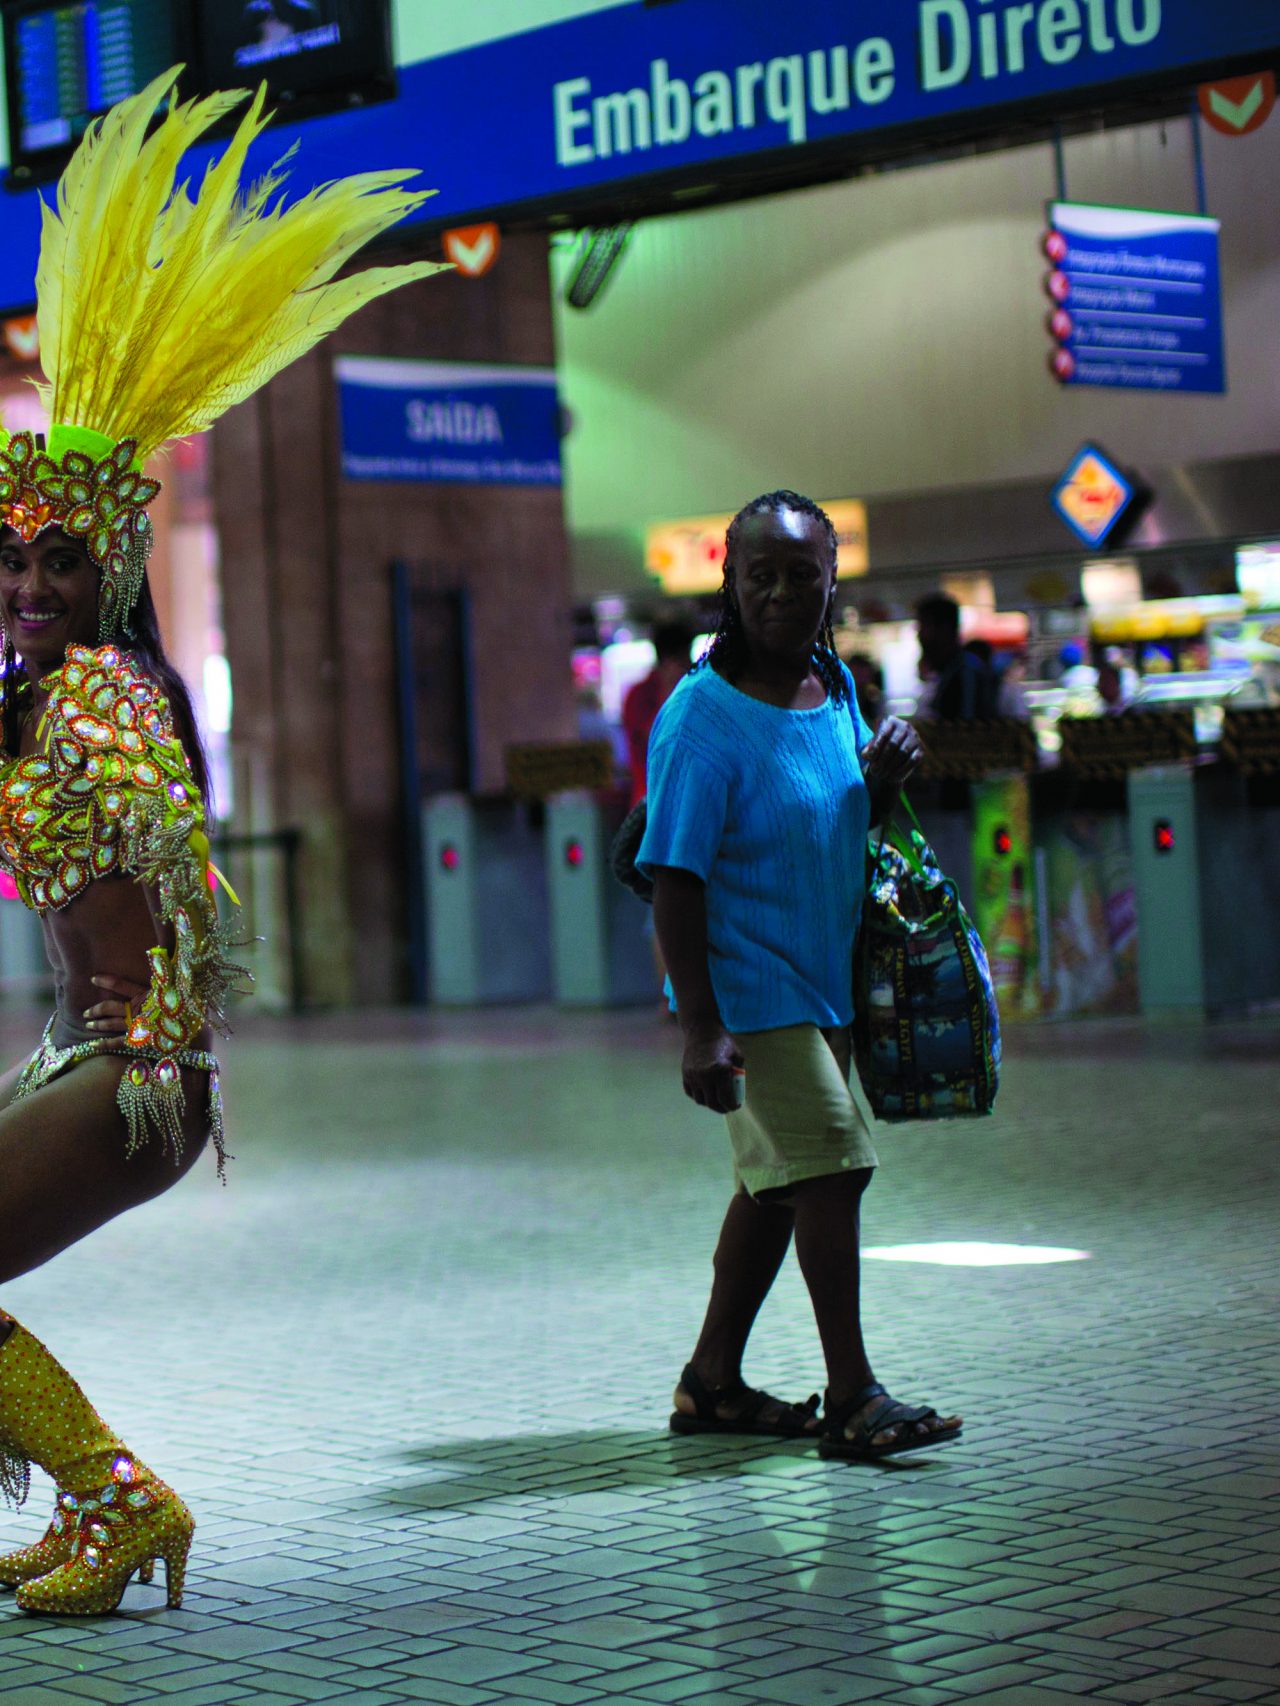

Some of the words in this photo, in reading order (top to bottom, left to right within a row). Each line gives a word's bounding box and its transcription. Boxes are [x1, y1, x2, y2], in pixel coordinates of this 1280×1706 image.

[553, 37, 896, 166] Embarque
[920, 0, 1162, 91] Direto
[899, 1018, 912, 1062] EGYPT
